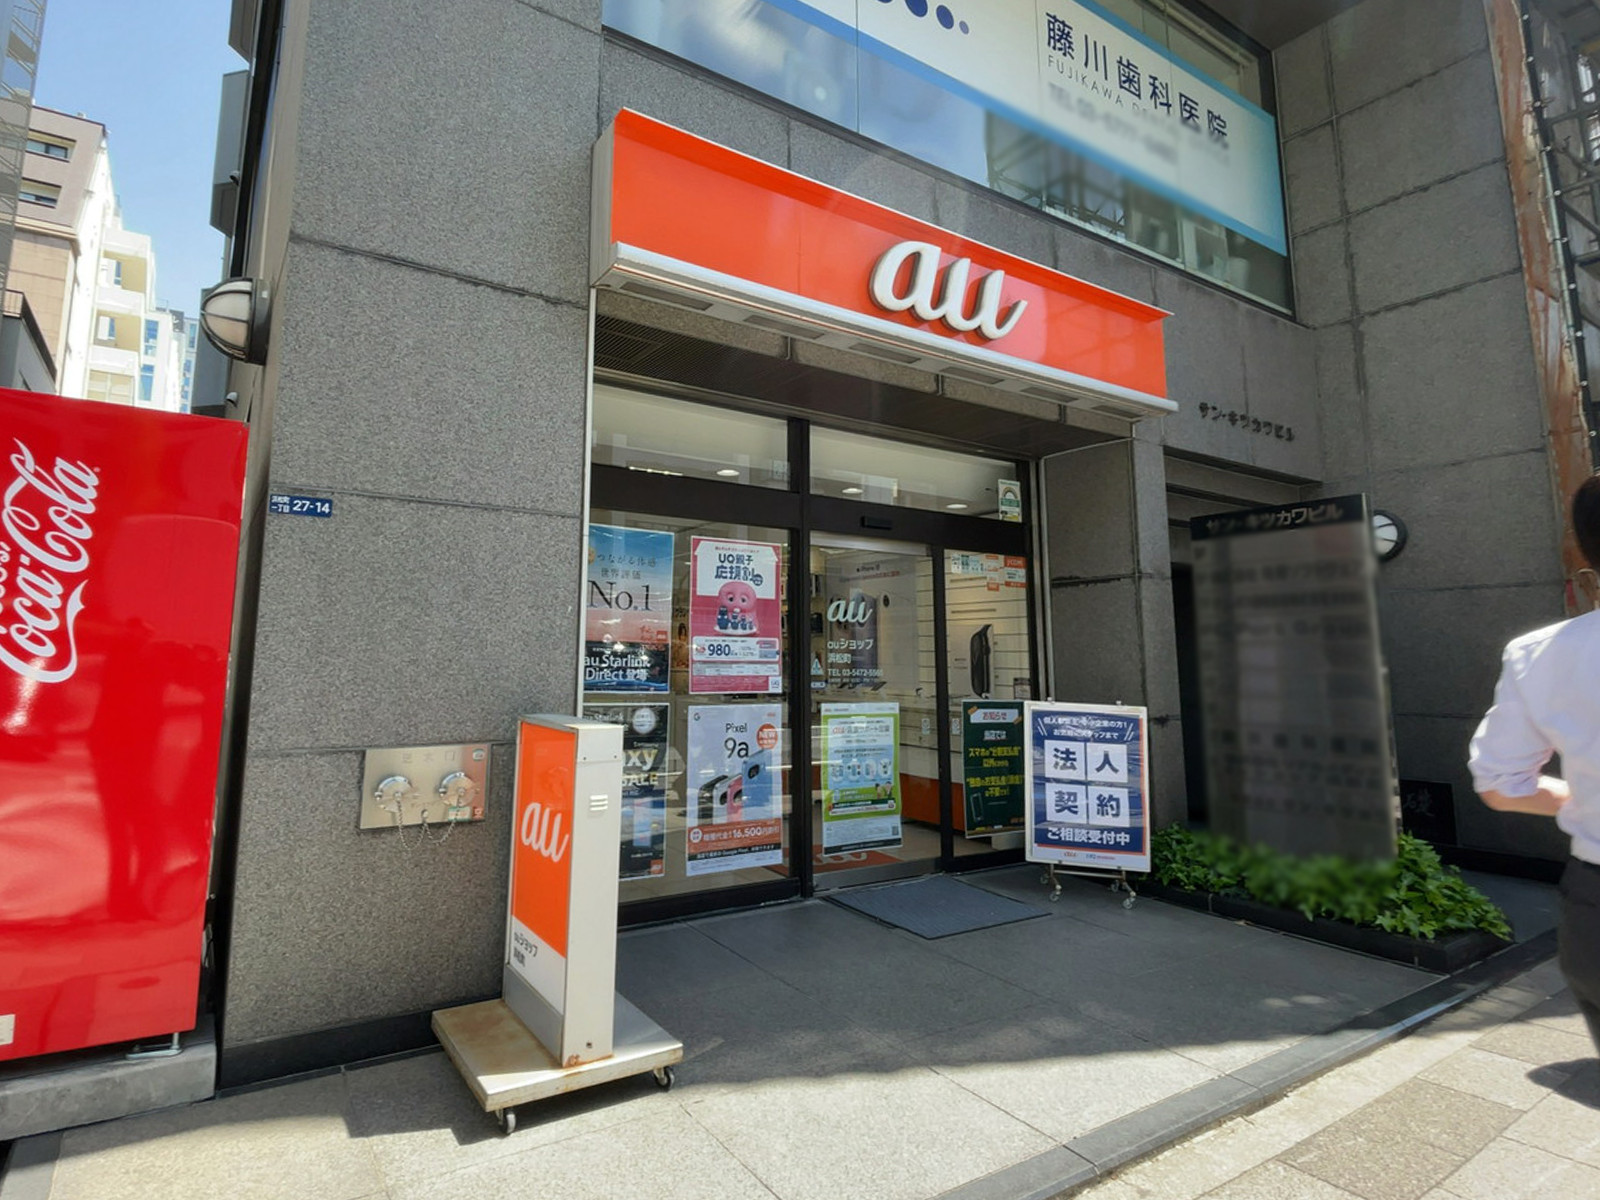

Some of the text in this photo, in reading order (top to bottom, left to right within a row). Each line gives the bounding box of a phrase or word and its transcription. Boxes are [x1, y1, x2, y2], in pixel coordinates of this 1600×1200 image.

[1046, 12, 1229, 147] 藤川歯科医院
[1048, 55, 1124, 106] FUJIKAWA
[869, 241, 1028, 340] au
[292, 500, 330, 514] 27-14
[588, 580, 654, 611] No.1
[827, 600, 873, 623] au
[707, 643, 731, 657] 980
[827, 638, 874, 650] auショップ
[602, 654, 651, 668] Starlink
[586, 668, 625, 681] Direct
[828, 668, 842, 677] TEL
[725, 722, 748, 733] Pixel
[724, 737, 749, 759] 9a
[1053, 747, 1119, 775] 法人
[1054, 791, 1121, 818] 契約
[521, 802, 569, 862] au
[1047, 826, 1131, 847] ご相談受付中
